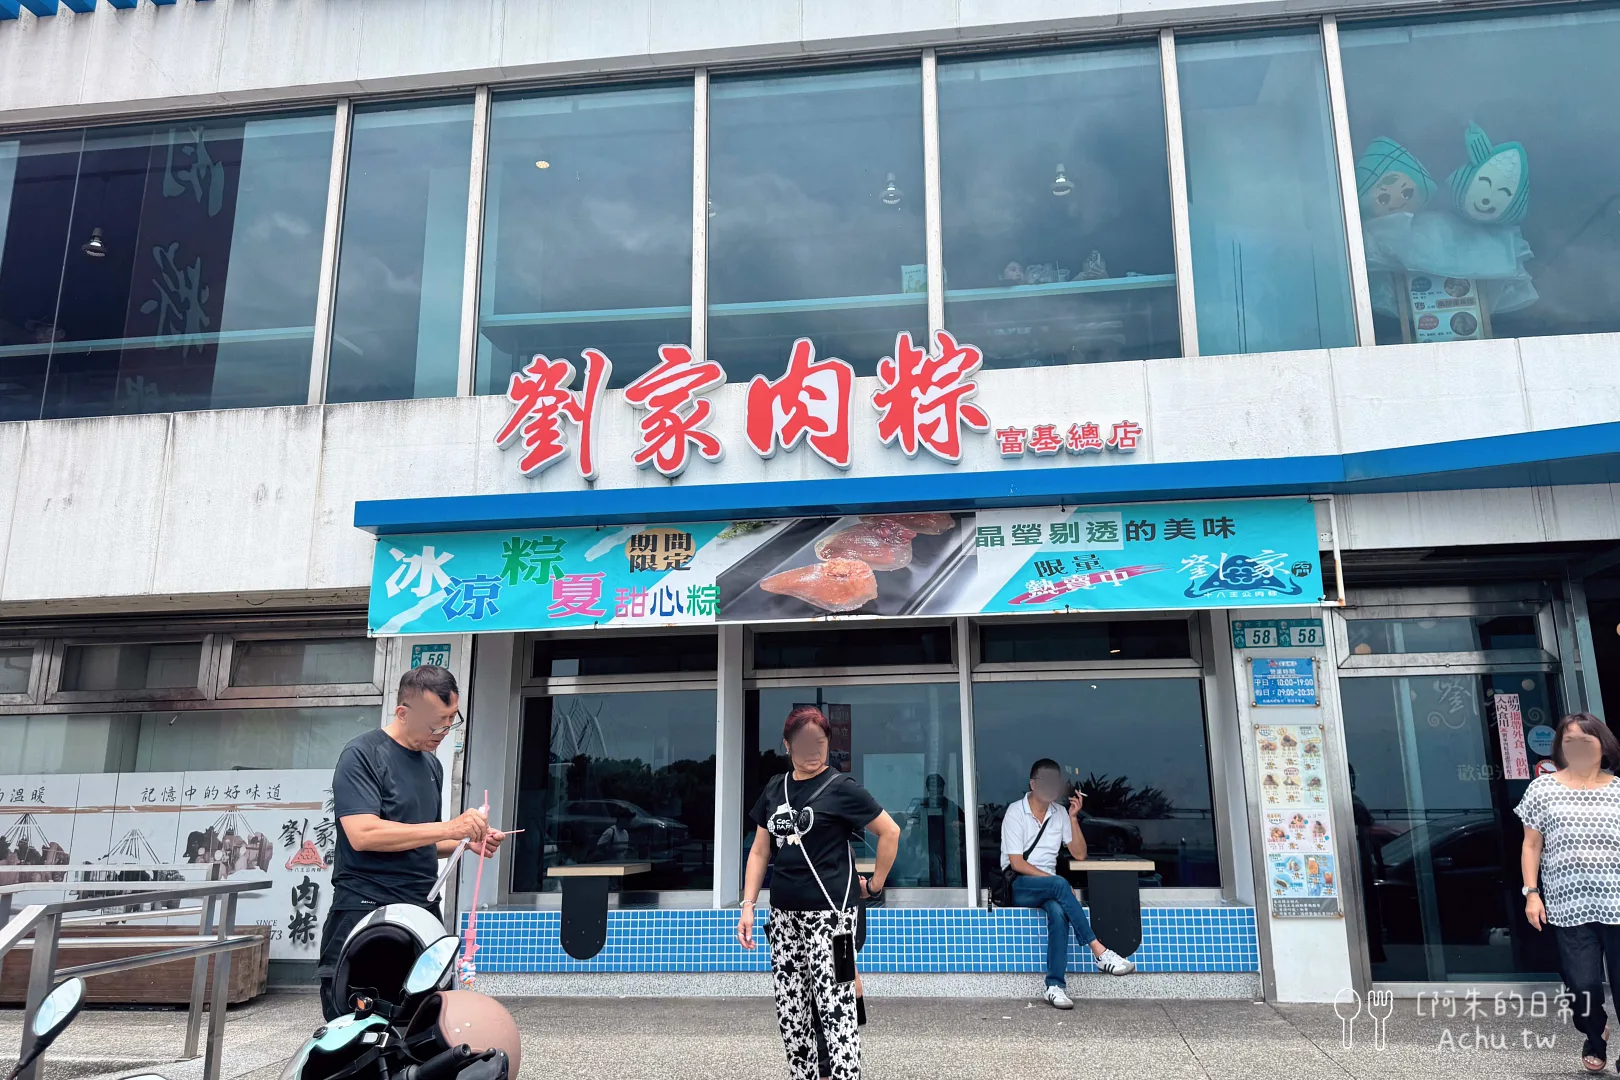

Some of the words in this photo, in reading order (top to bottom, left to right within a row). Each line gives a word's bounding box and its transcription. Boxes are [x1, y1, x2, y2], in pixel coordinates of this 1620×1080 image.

[496, 330, 989, 480] 劉家肉粽
[997, 421, 1143, 456] 富基總店
[975, 517, 1236, 548] 晶瑩剔透的美味
[1033, 553, 1104, 578] 限量
[1175, 549, 1290, 581] 劉家
[1025, 569, 1129, 598] 熱賣中
[1252, 629, 1271, 645] 58
[1298, 628, 1316, 643] 58
[427, 652, 444, 667] 58
[141, 783, 282, 802] 記憶中的好味道
[278, 817, 336, 850] 劉家
[255, 919, 278, 927] SINCE
[287, 875, 320, 946] 肉粽
